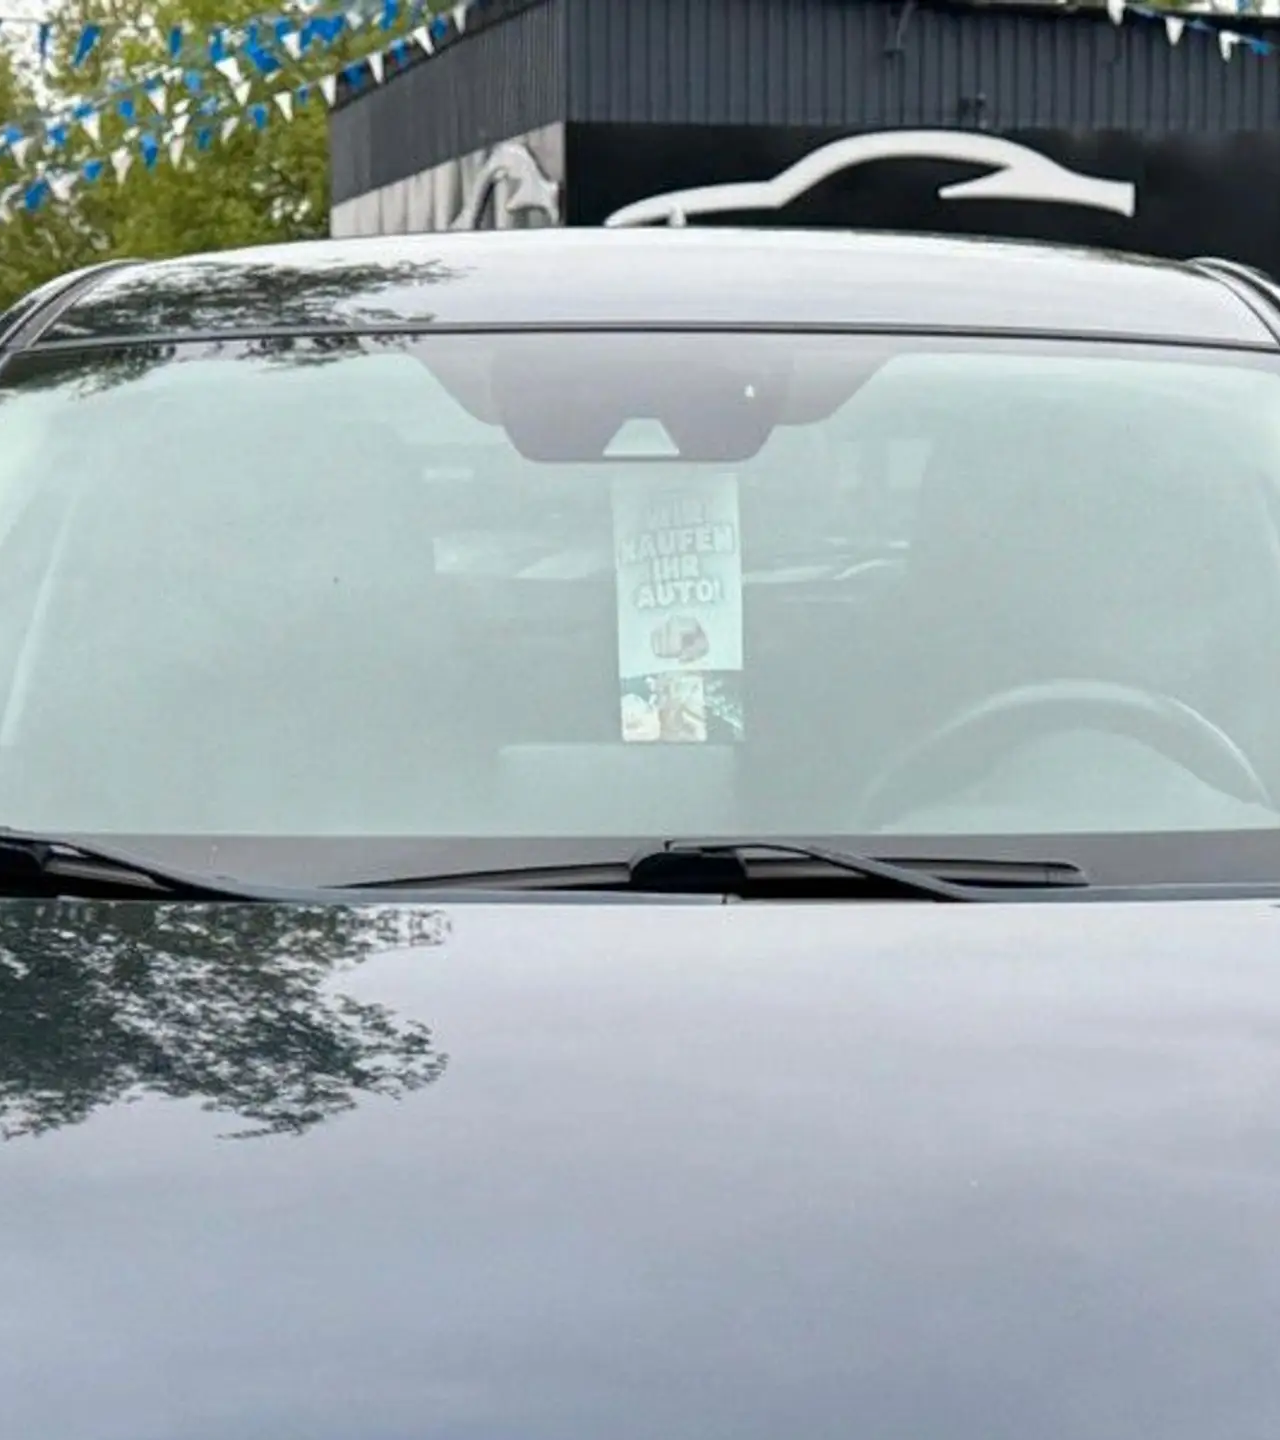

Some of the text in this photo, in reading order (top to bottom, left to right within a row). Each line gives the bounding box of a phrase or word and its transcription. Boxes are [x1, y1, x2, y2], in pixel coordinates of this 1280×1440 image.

[619, 523, 734, 565] KAUFEN
[652, 554, 700, 582] IHR
[635, 576, 725, 609] AUTO!
